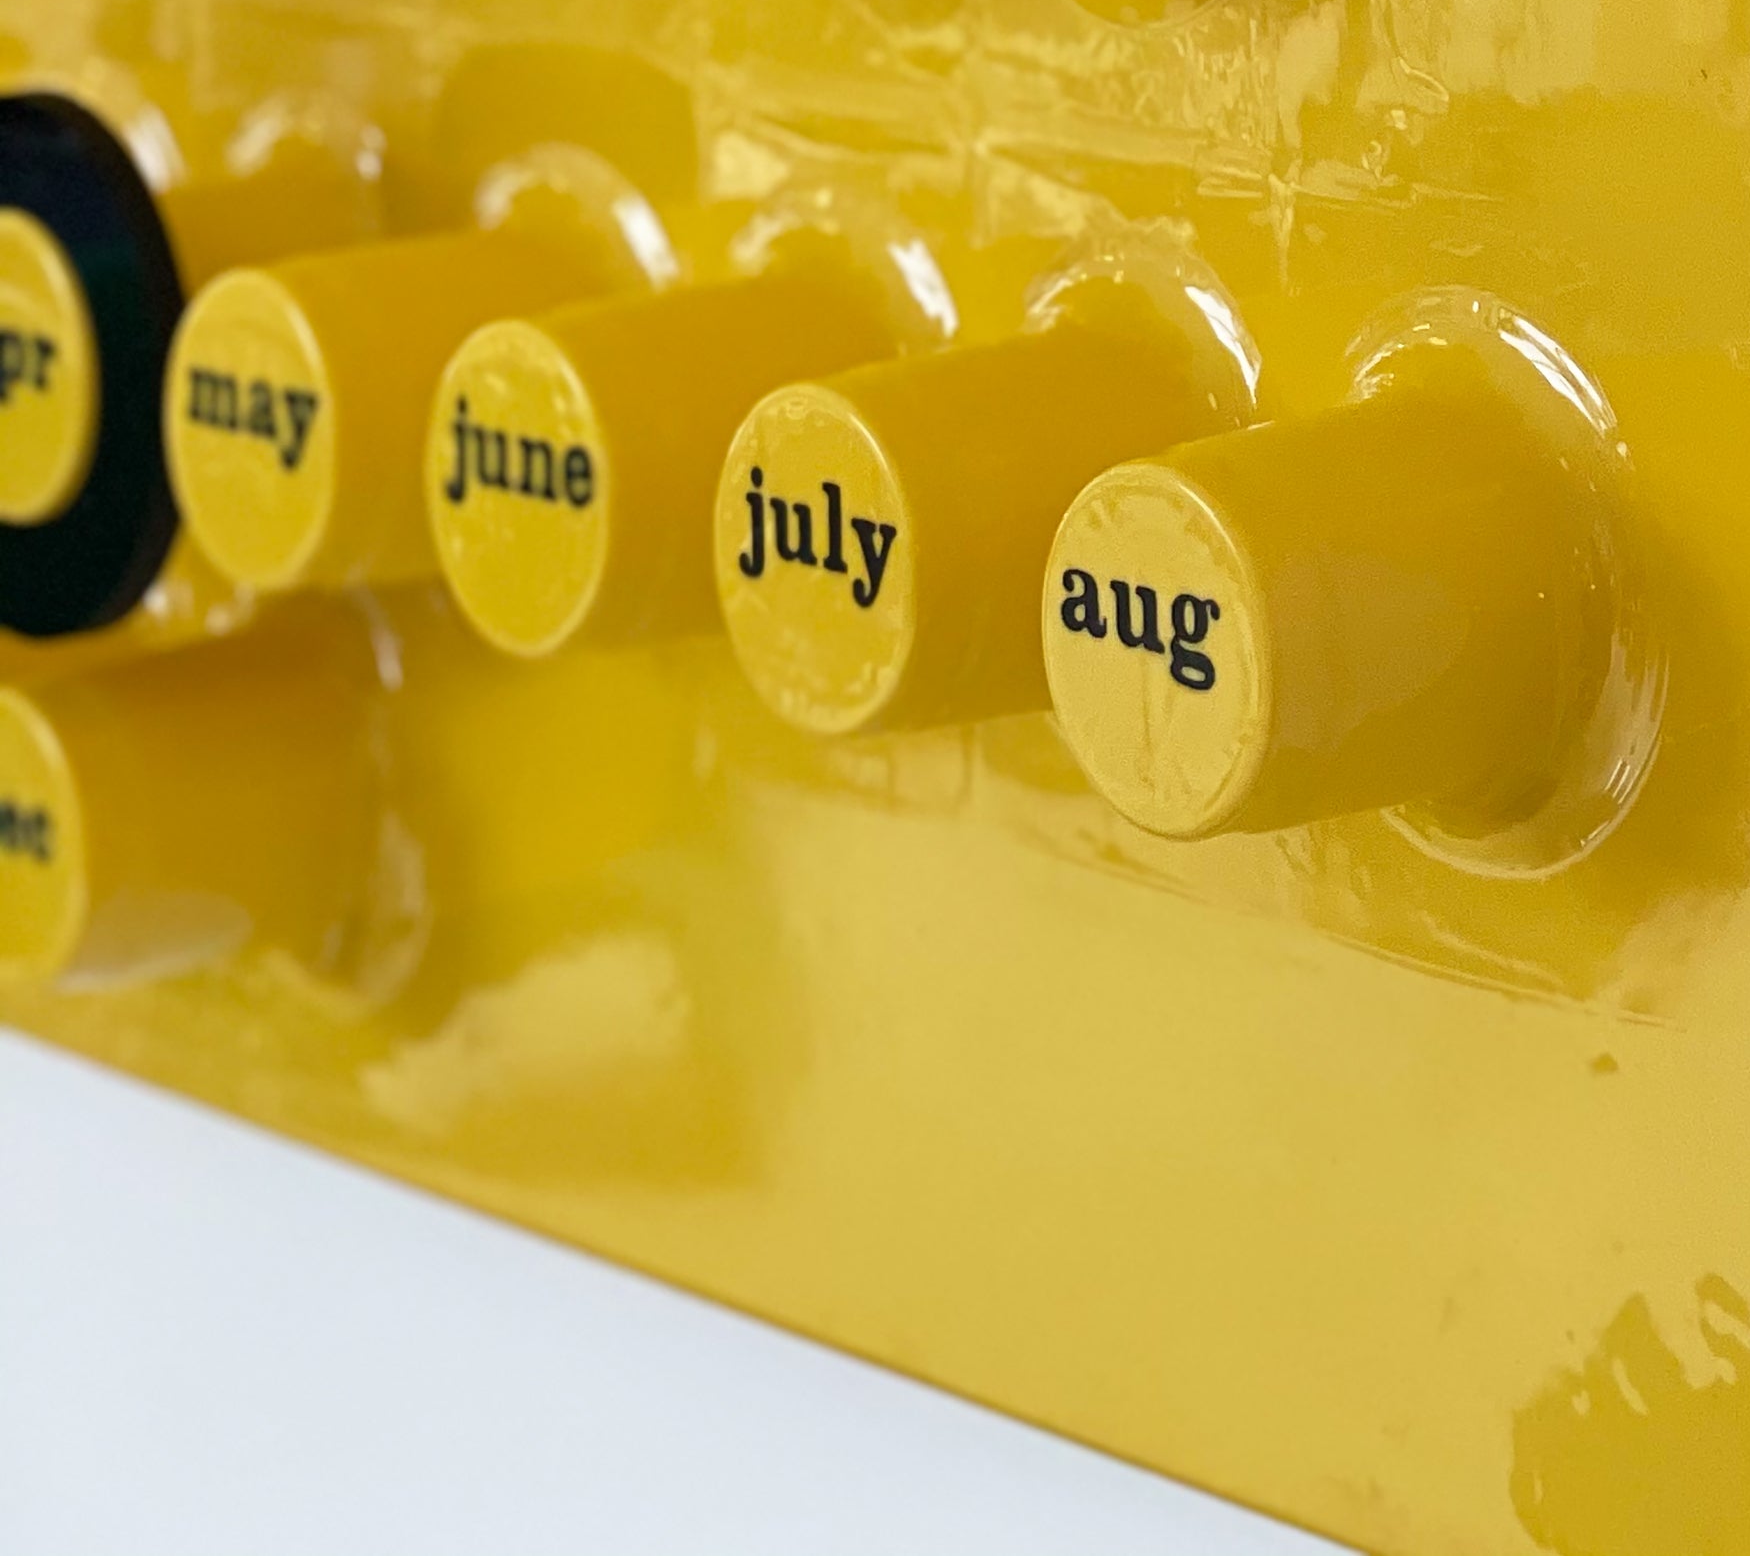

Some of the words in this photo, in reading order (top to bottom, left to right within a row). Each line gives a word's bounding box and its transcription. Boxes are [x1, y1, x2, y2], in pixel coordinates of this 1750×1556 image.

[0, 328, 56, 405] pr
[187, 368, 319, 472] may
[444, 396, 594, 510] june
[739, 467, 897, 608] july
[1061, 569, 1220, 691] aug
